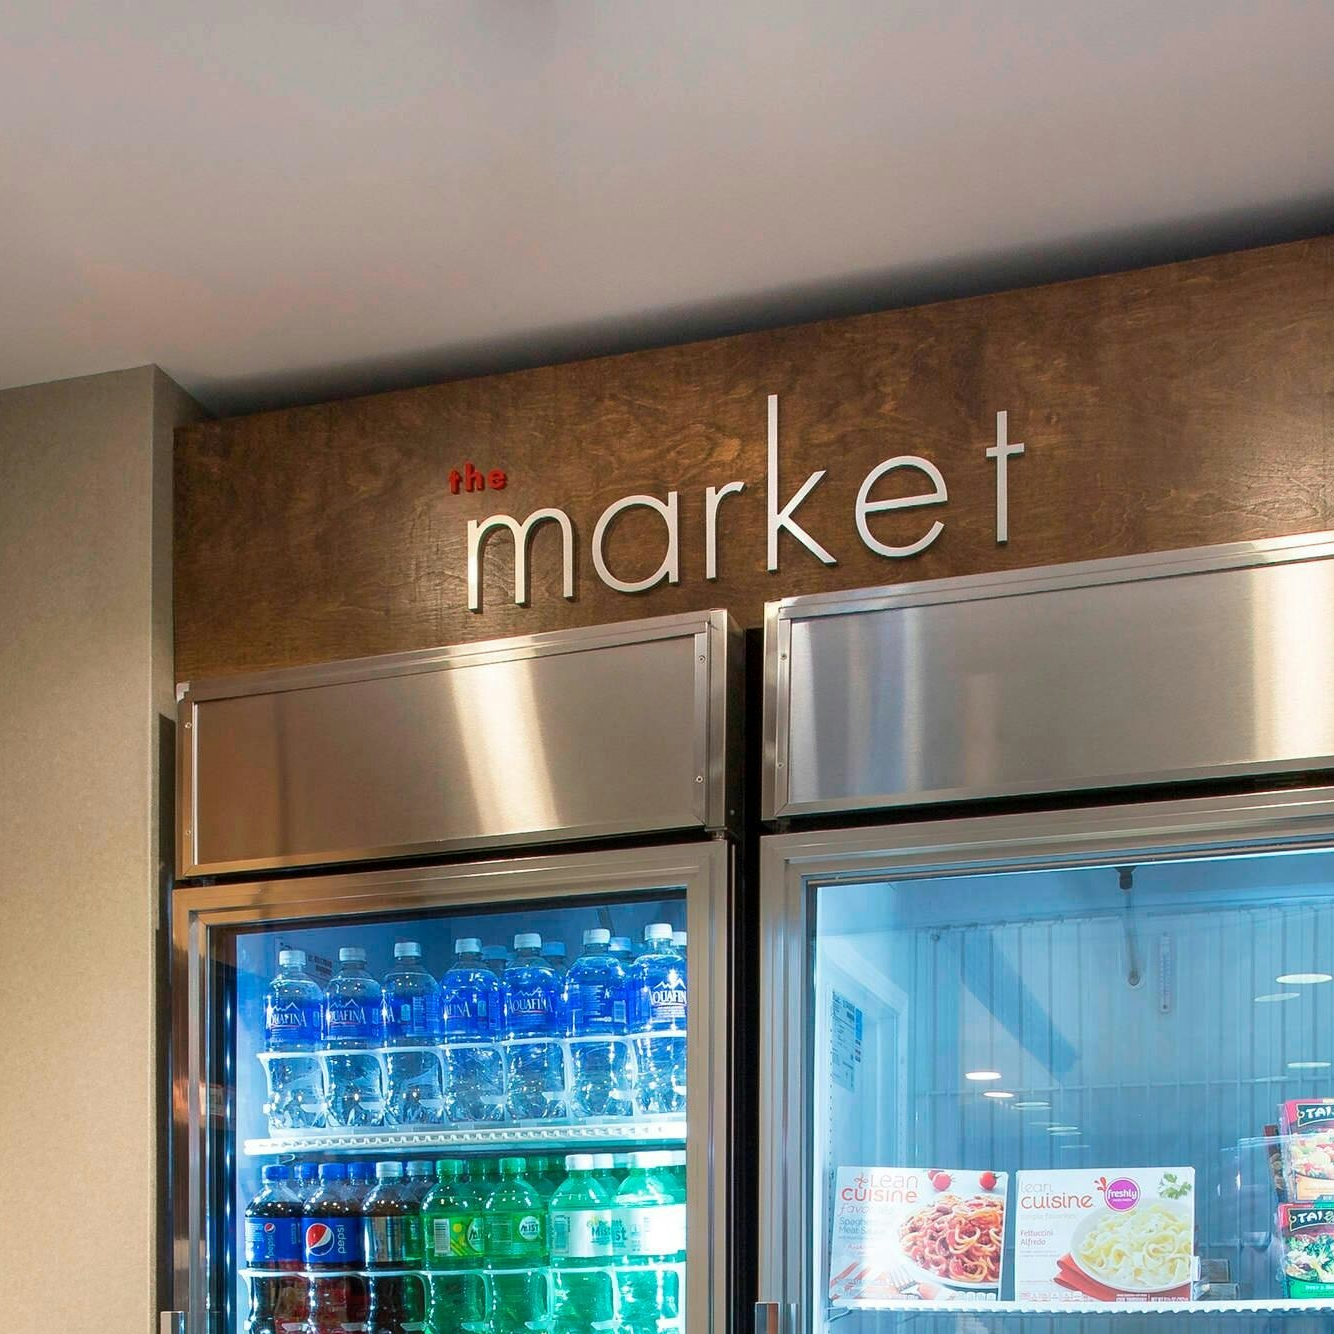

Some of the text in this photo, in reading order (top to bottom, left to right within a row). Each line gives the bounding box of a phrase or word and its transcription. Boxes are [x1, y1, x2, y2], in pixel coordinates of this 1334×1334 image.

[448, 463, 508, 495] the
[468, 394, 1025, 611] market
[648, 989, 687, 1006] AQUAFIN
[1306, 1106, 1331, 1119] TAI
[1020, 1193, 1094, 1209] cuisine
[1107, 1188, 1138, 1200] freshly
[1297, 1211, 1323, 1224] TAI
[266, 1232, 276, 1259] pepsi
[337, 1223, 347, 1254] pepsi
[1020, 1238, 1046, 1247] Alfredo
